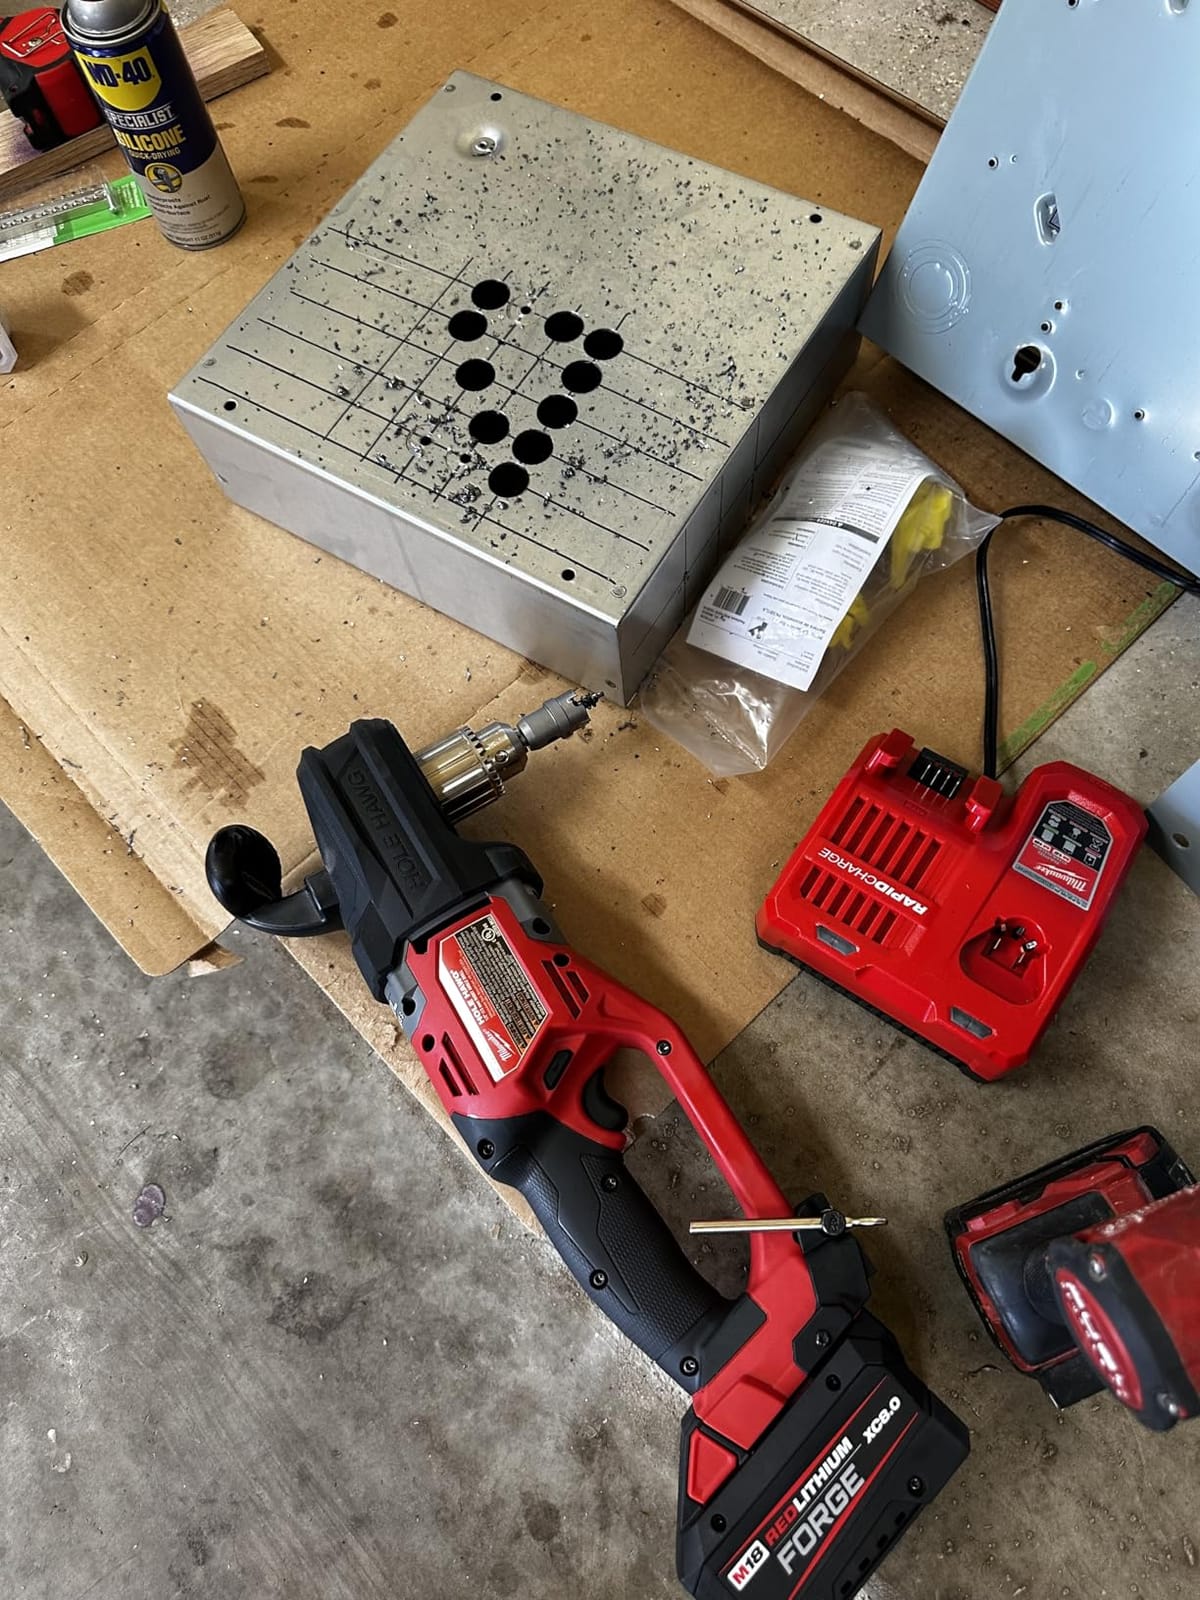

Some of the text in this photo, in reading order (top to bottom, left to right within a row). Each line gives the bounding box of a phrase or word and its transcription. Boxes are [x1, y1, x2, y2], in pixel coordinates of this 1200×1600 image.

[84, 58, 152, 88] WD-40
[115, 125, 186, 150] SILICONE
[347, 769, 389, 833] HAWG
[818, 847, 928, 916] RAPIDCHARGE
[1032, 863, 1086, 891] Milwaukee
[451, 970, 485, 1025] HOLE HAWG
[732, 1396, 902, 1586] M18 REDLITHIUM XC8.0
[776, 1462, 866, 1576] FORGE
